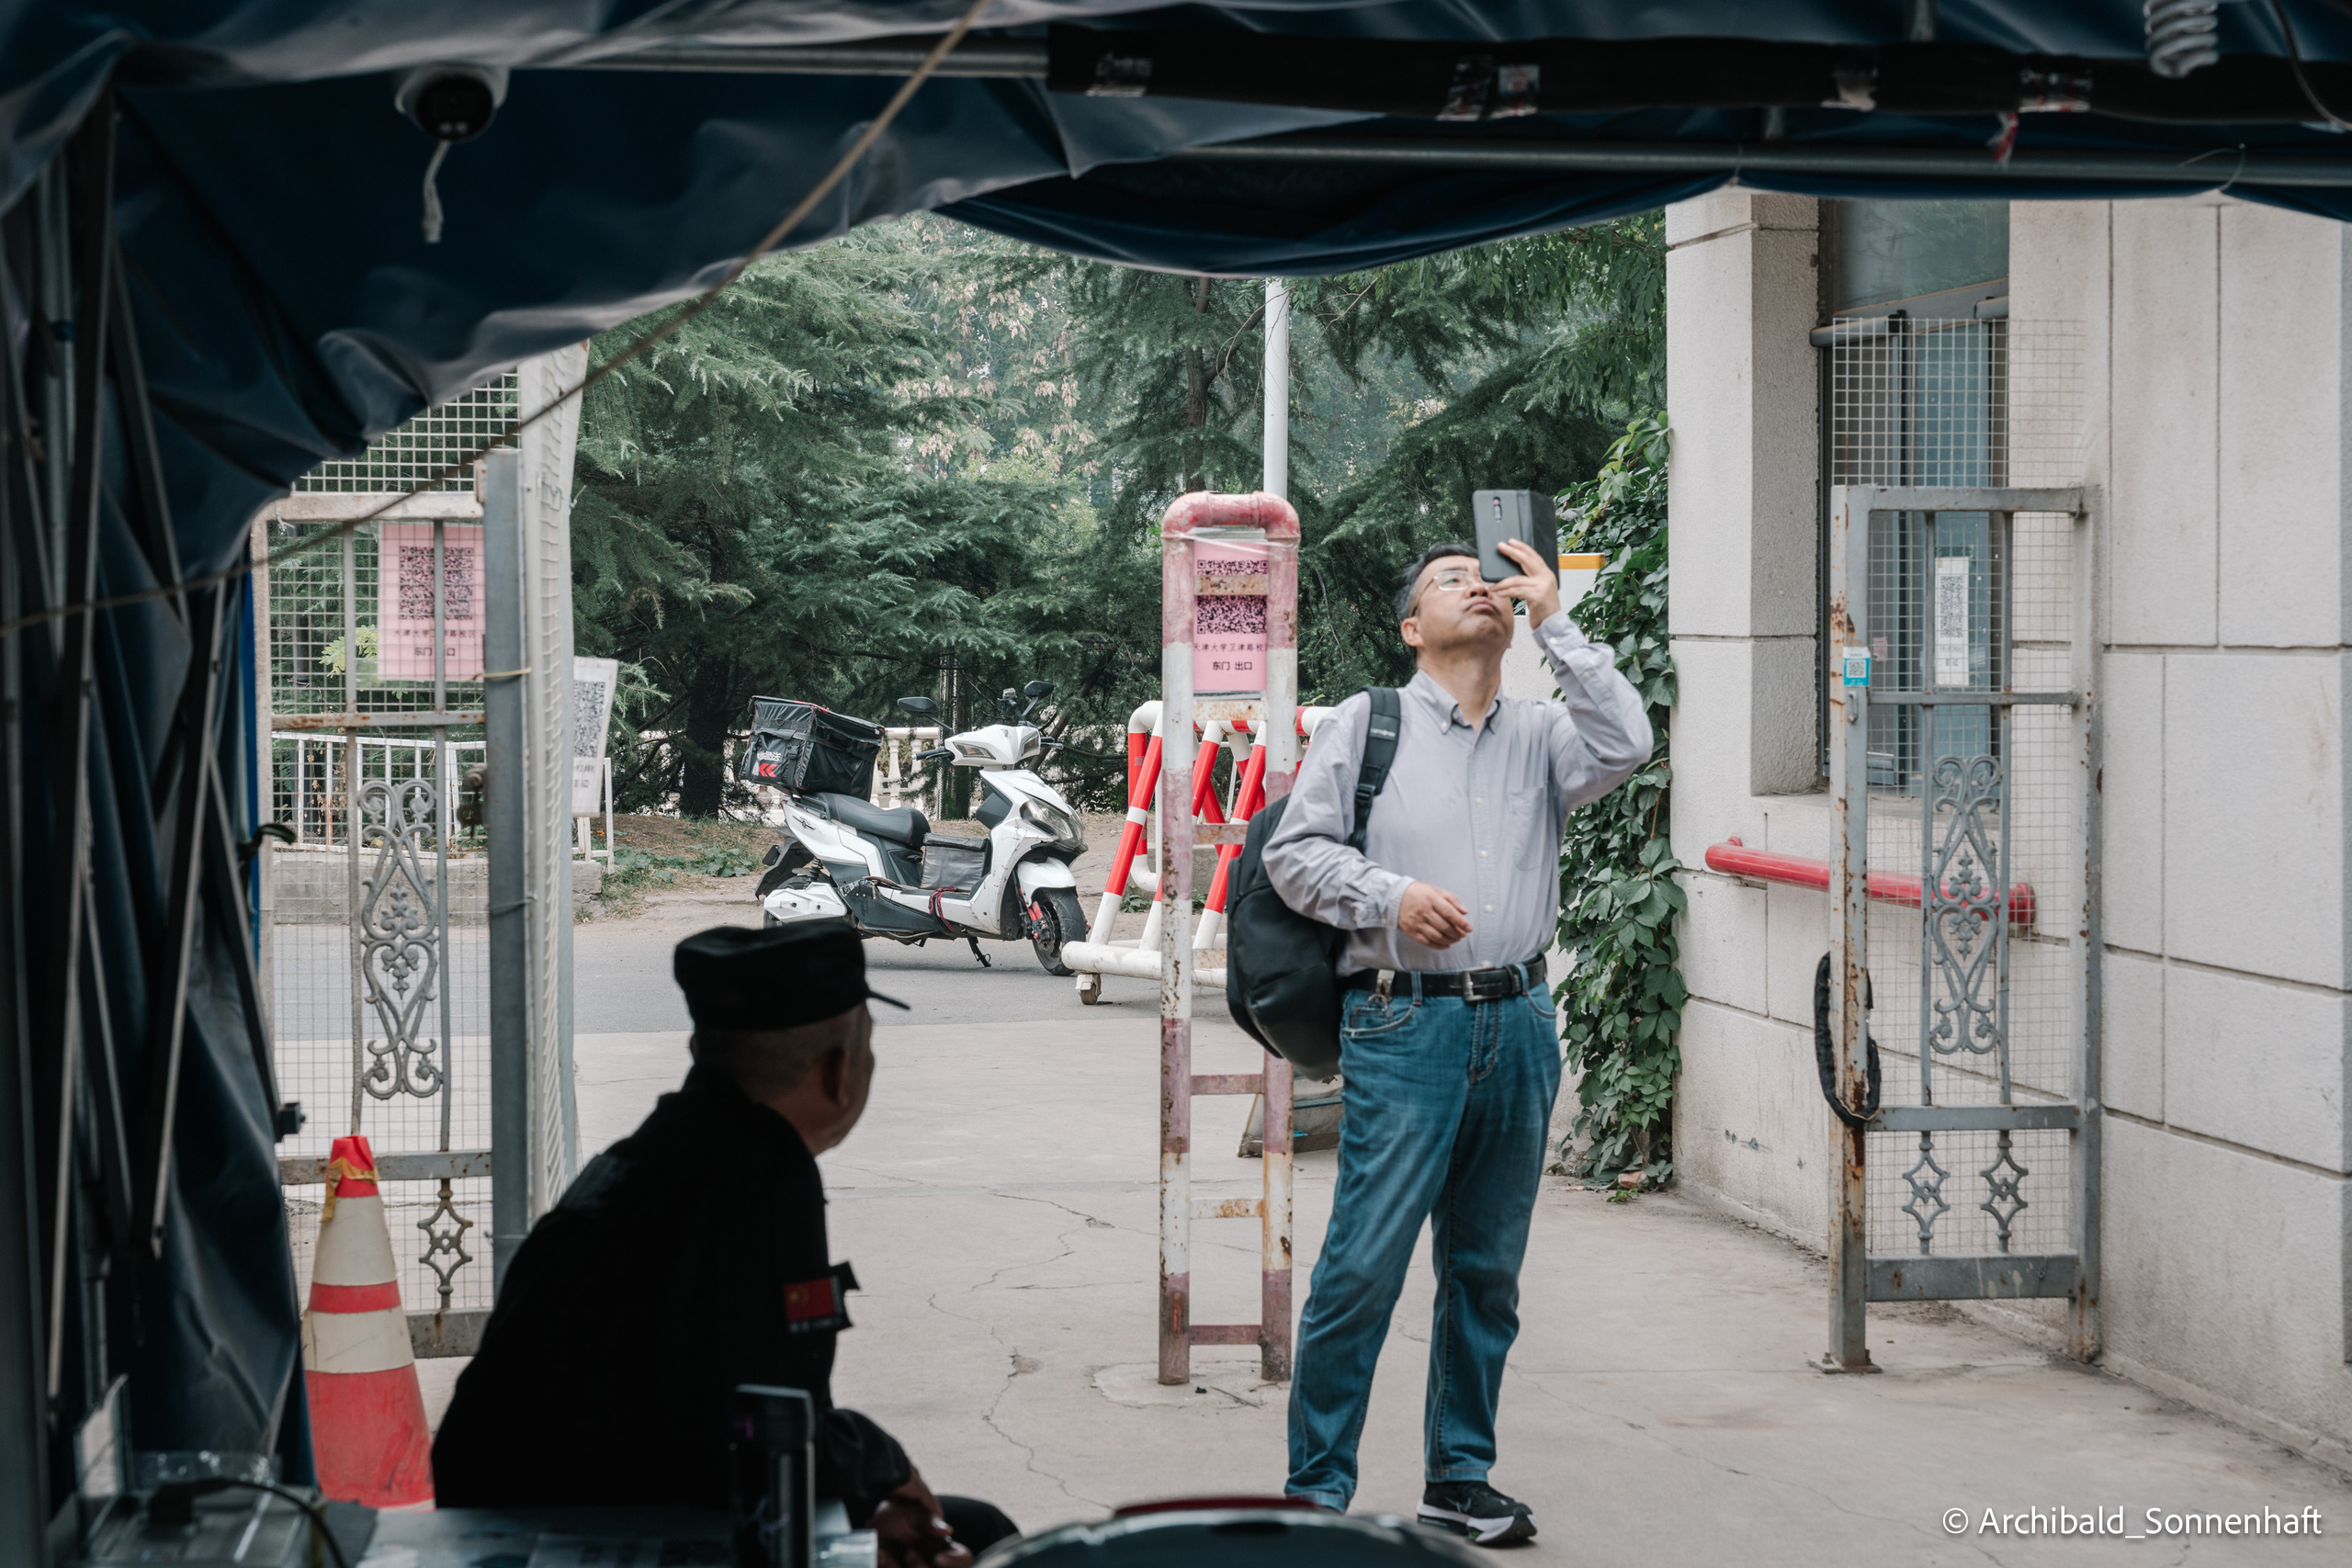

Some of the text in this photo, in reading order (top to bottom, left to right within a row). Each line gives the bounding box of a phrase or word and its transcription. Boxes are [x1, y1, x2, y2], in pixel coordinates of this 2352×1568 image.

[1193, 643, 1268, 652] 天津大学卫津路校
[1212, 661, 1253, 671] 东门 出口
